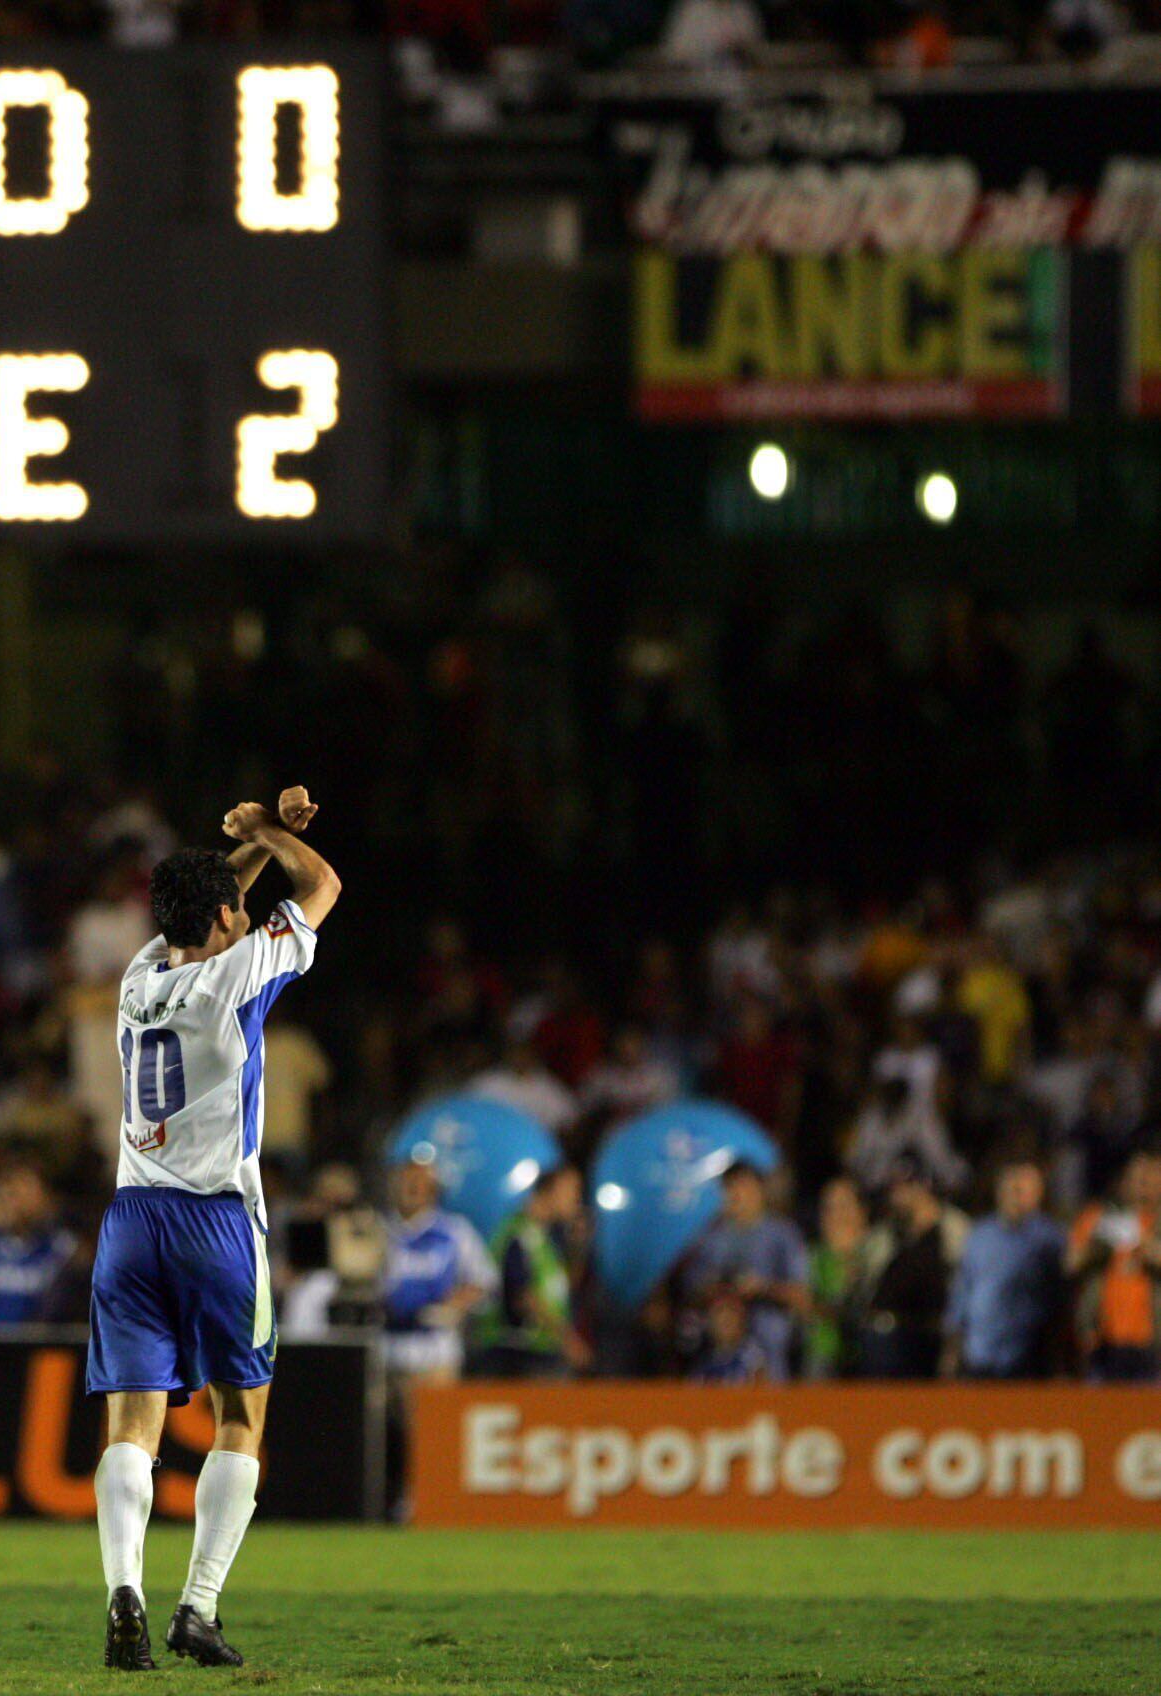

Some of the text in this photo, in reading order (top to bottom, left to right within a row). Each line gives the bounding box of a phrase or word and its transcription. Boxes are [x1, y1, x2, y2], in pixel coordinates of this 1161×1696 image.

[236, 65, 340, 232] 0
[236, 349, 338, 518] 2
[121, 1028, 186, 1124] 10
[461, 1403, 842, 1514] Esporte
[874, 1430, 1081, 1495] com
